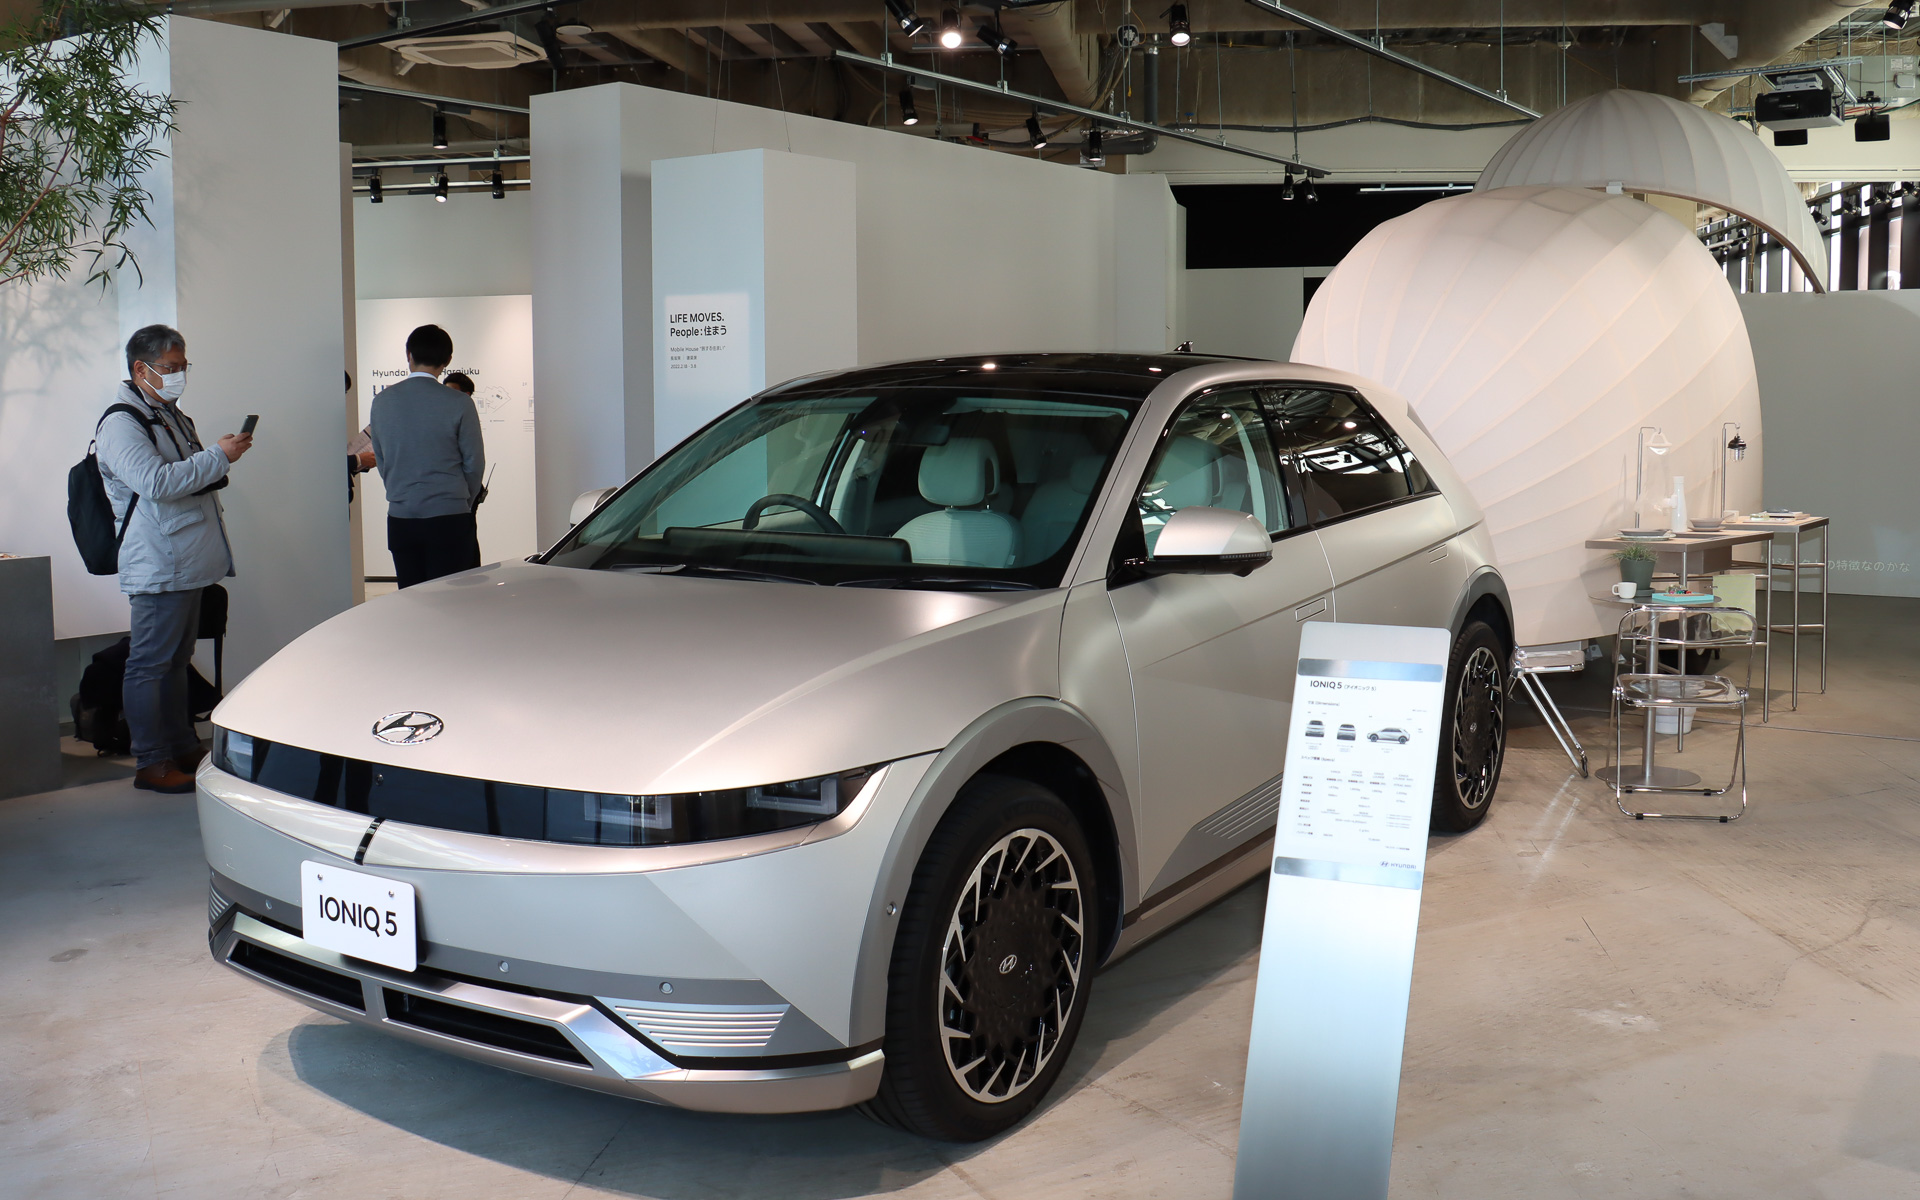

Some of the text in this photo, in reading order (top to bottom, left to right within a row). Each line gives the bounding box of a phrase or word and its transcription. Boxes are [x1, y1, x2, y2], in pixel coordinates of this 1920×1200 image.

[670, 312, 725, 323] LIFE MOVES.
[372, 368, 409, 379] Hyundai
[1310, 680, 1336, 690] IONIQ
[1336, 681, 1343, 690] 5
[1390, 862, 1417, 870] HYUNDAI
[319, 894, 398, 938] IONIQ 5
